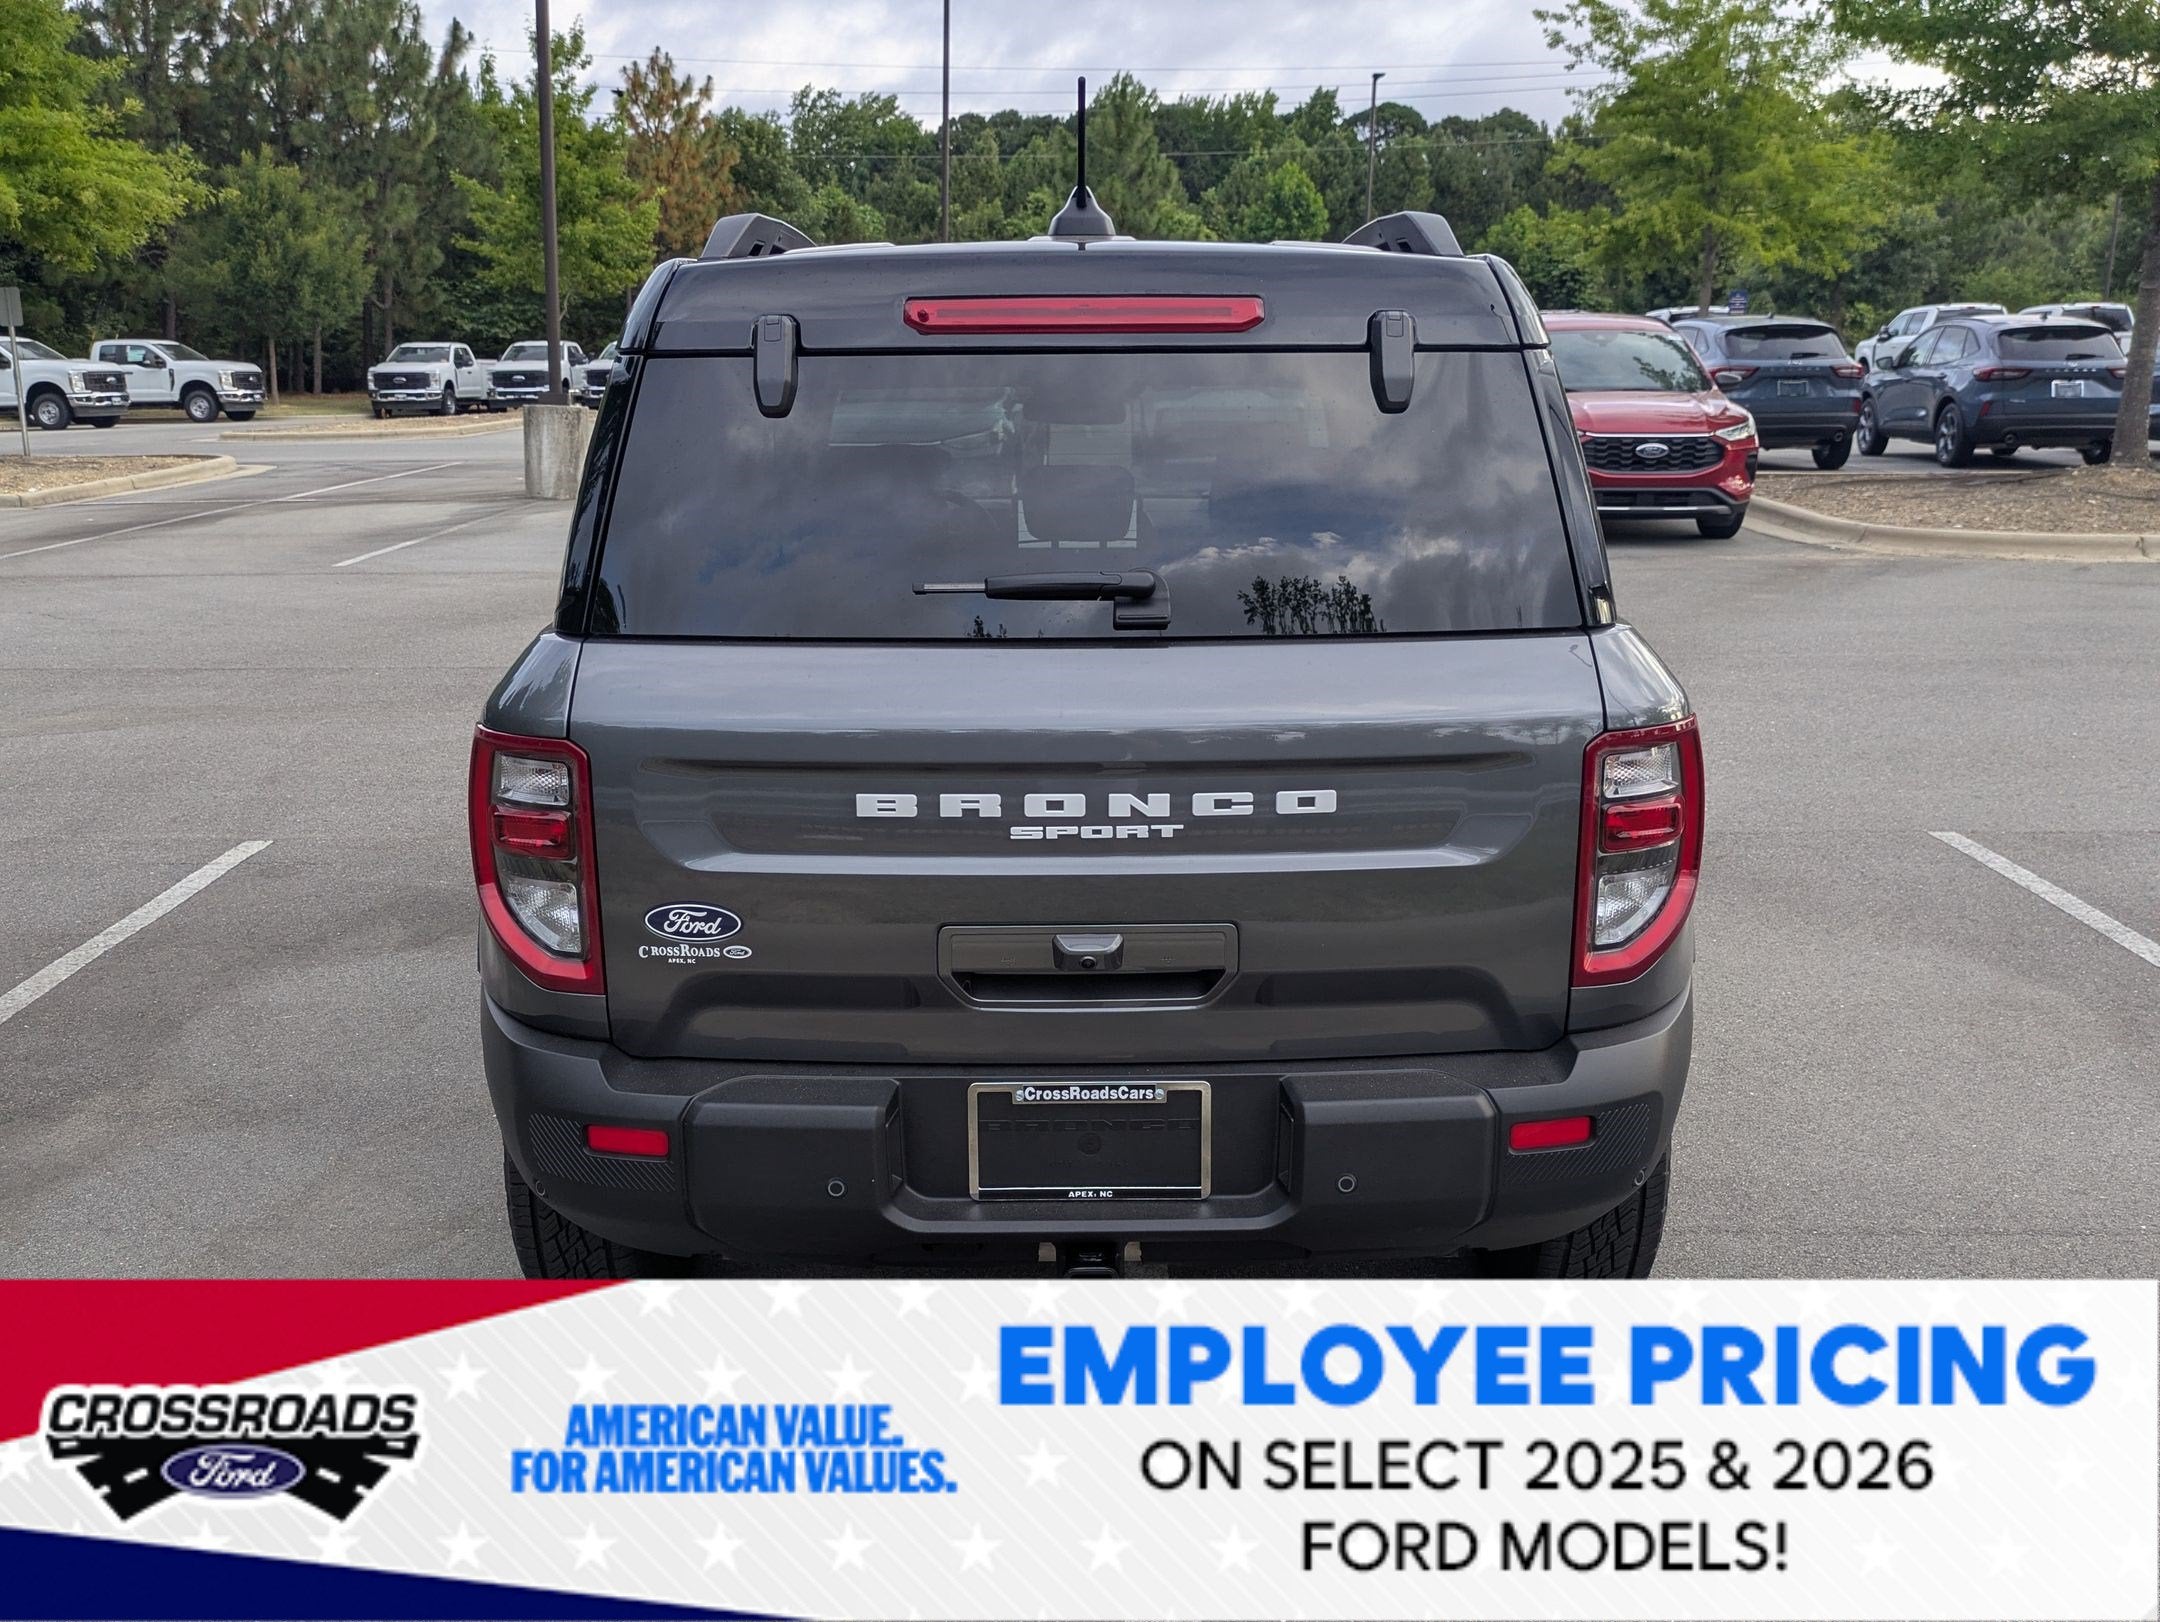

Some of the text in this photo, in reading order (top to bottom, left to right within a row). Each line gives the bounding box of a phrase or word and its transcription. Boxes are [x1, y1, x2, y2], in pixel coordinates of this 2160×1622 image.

[856, 789, 1338, 818] BRONCO
[1010, 824, 1184, 840] SPORT
[663, 909, 722, 935] Ford
[1024, 1086, 1154, 1101] CrossRoadsCars
[1068, 1190, 1113, 1198] APEX, NC
